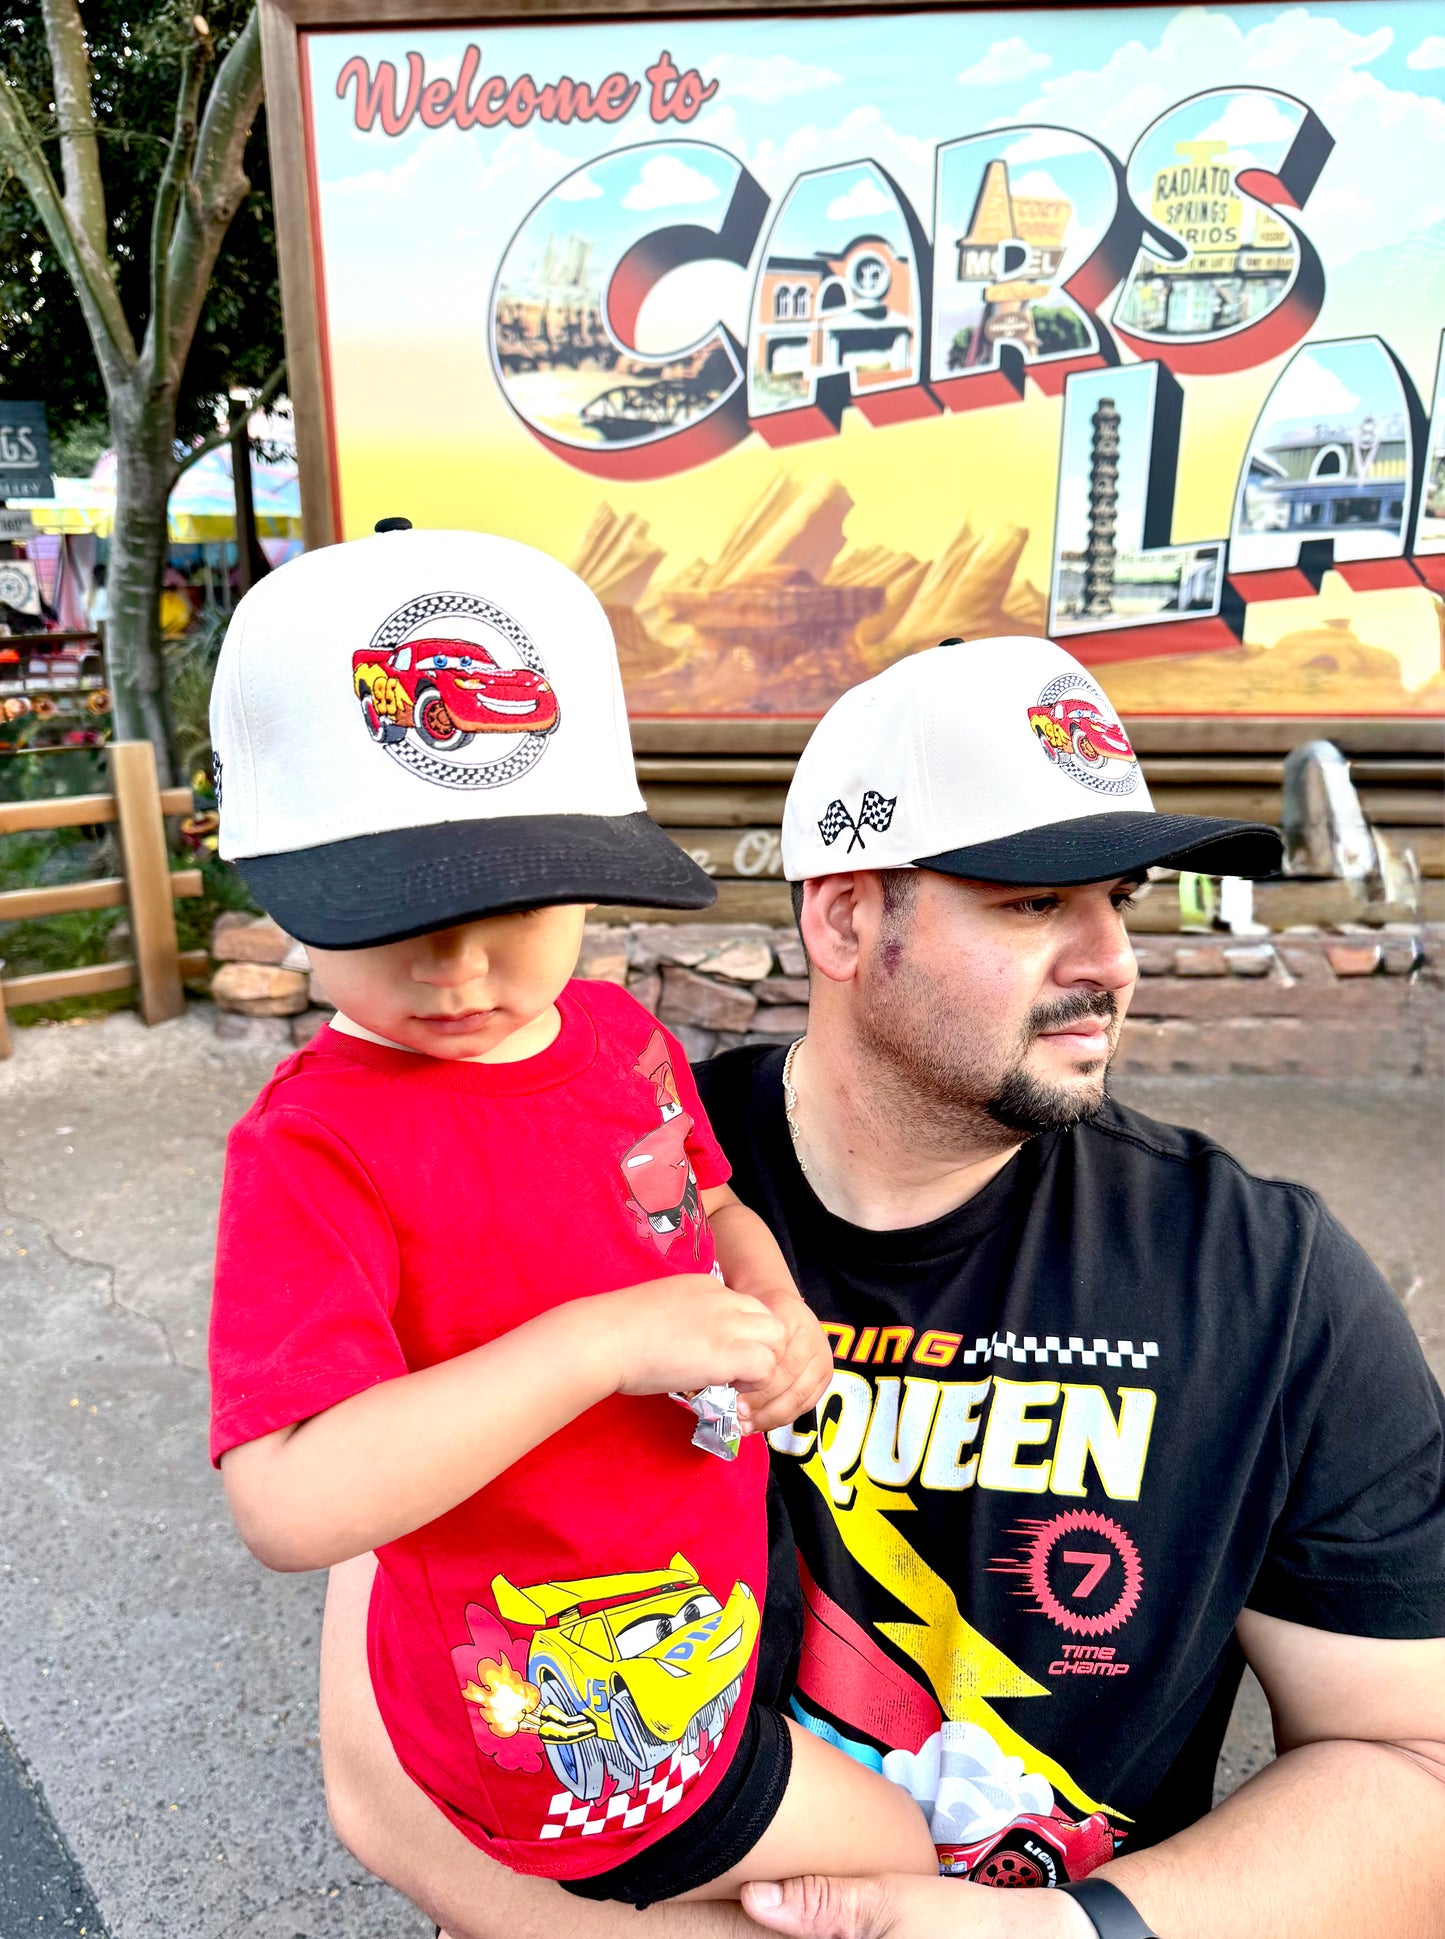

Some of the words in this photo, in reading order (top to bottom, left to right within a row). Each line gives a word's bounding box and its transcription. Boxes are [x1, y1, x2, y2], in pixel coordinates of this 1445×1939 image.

[337, 44, 641, 137] Welcome
[645, 50, 719, 125] to
[1156, 166, 1241, 201] RADIATO
[1166, 201, 1228, 225] SPRINGS
[1178, 227, 1237, 244] RIOS
[965, 250, 1057, 276] MOEL
[488, 85, 1335, 480] CARS
[1063, 1551, 1111, 1598] 7
